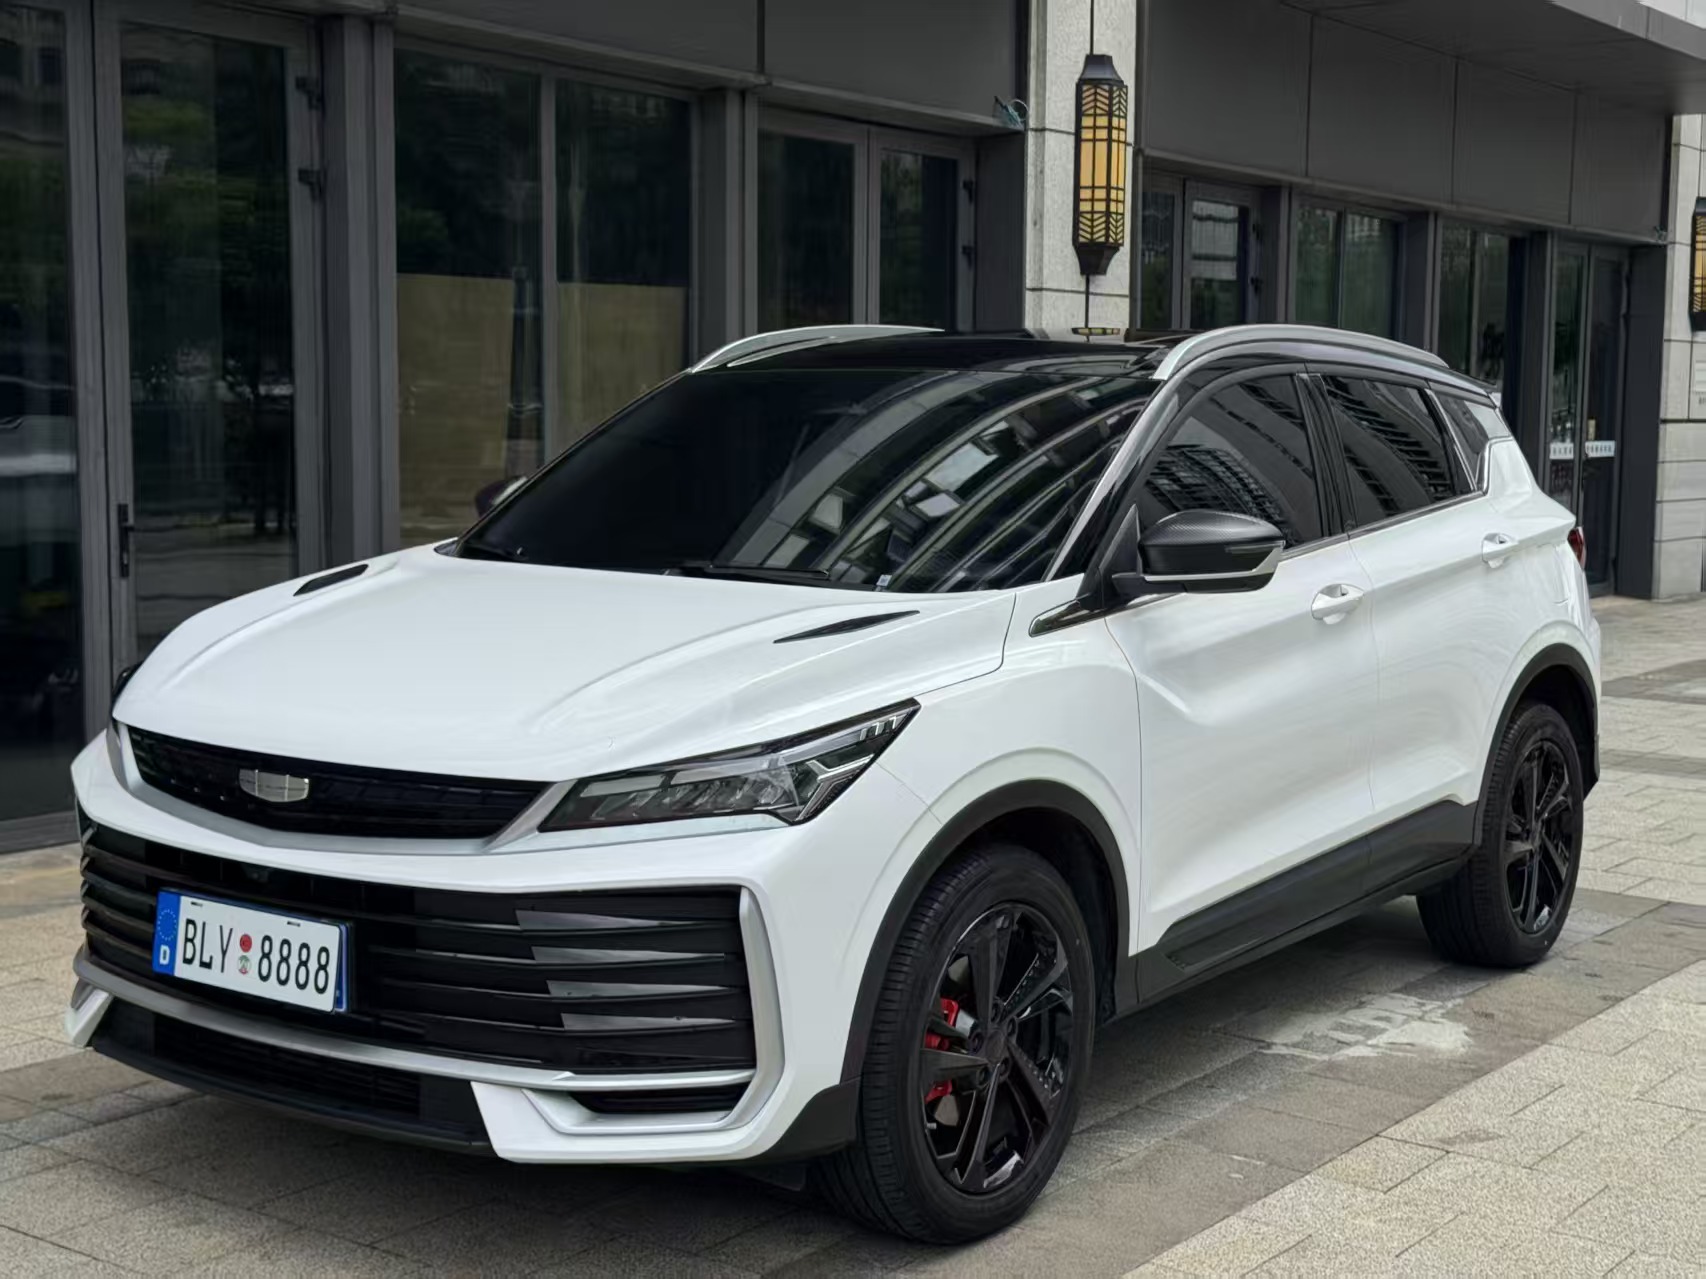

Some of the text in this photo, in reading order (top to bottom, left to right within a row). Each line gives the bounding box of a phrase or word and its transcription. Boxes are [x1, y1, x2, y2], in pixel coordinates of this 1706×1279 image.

[160, 945, 170, 965] D
[182, 918, 330, 995] BLY 8888
